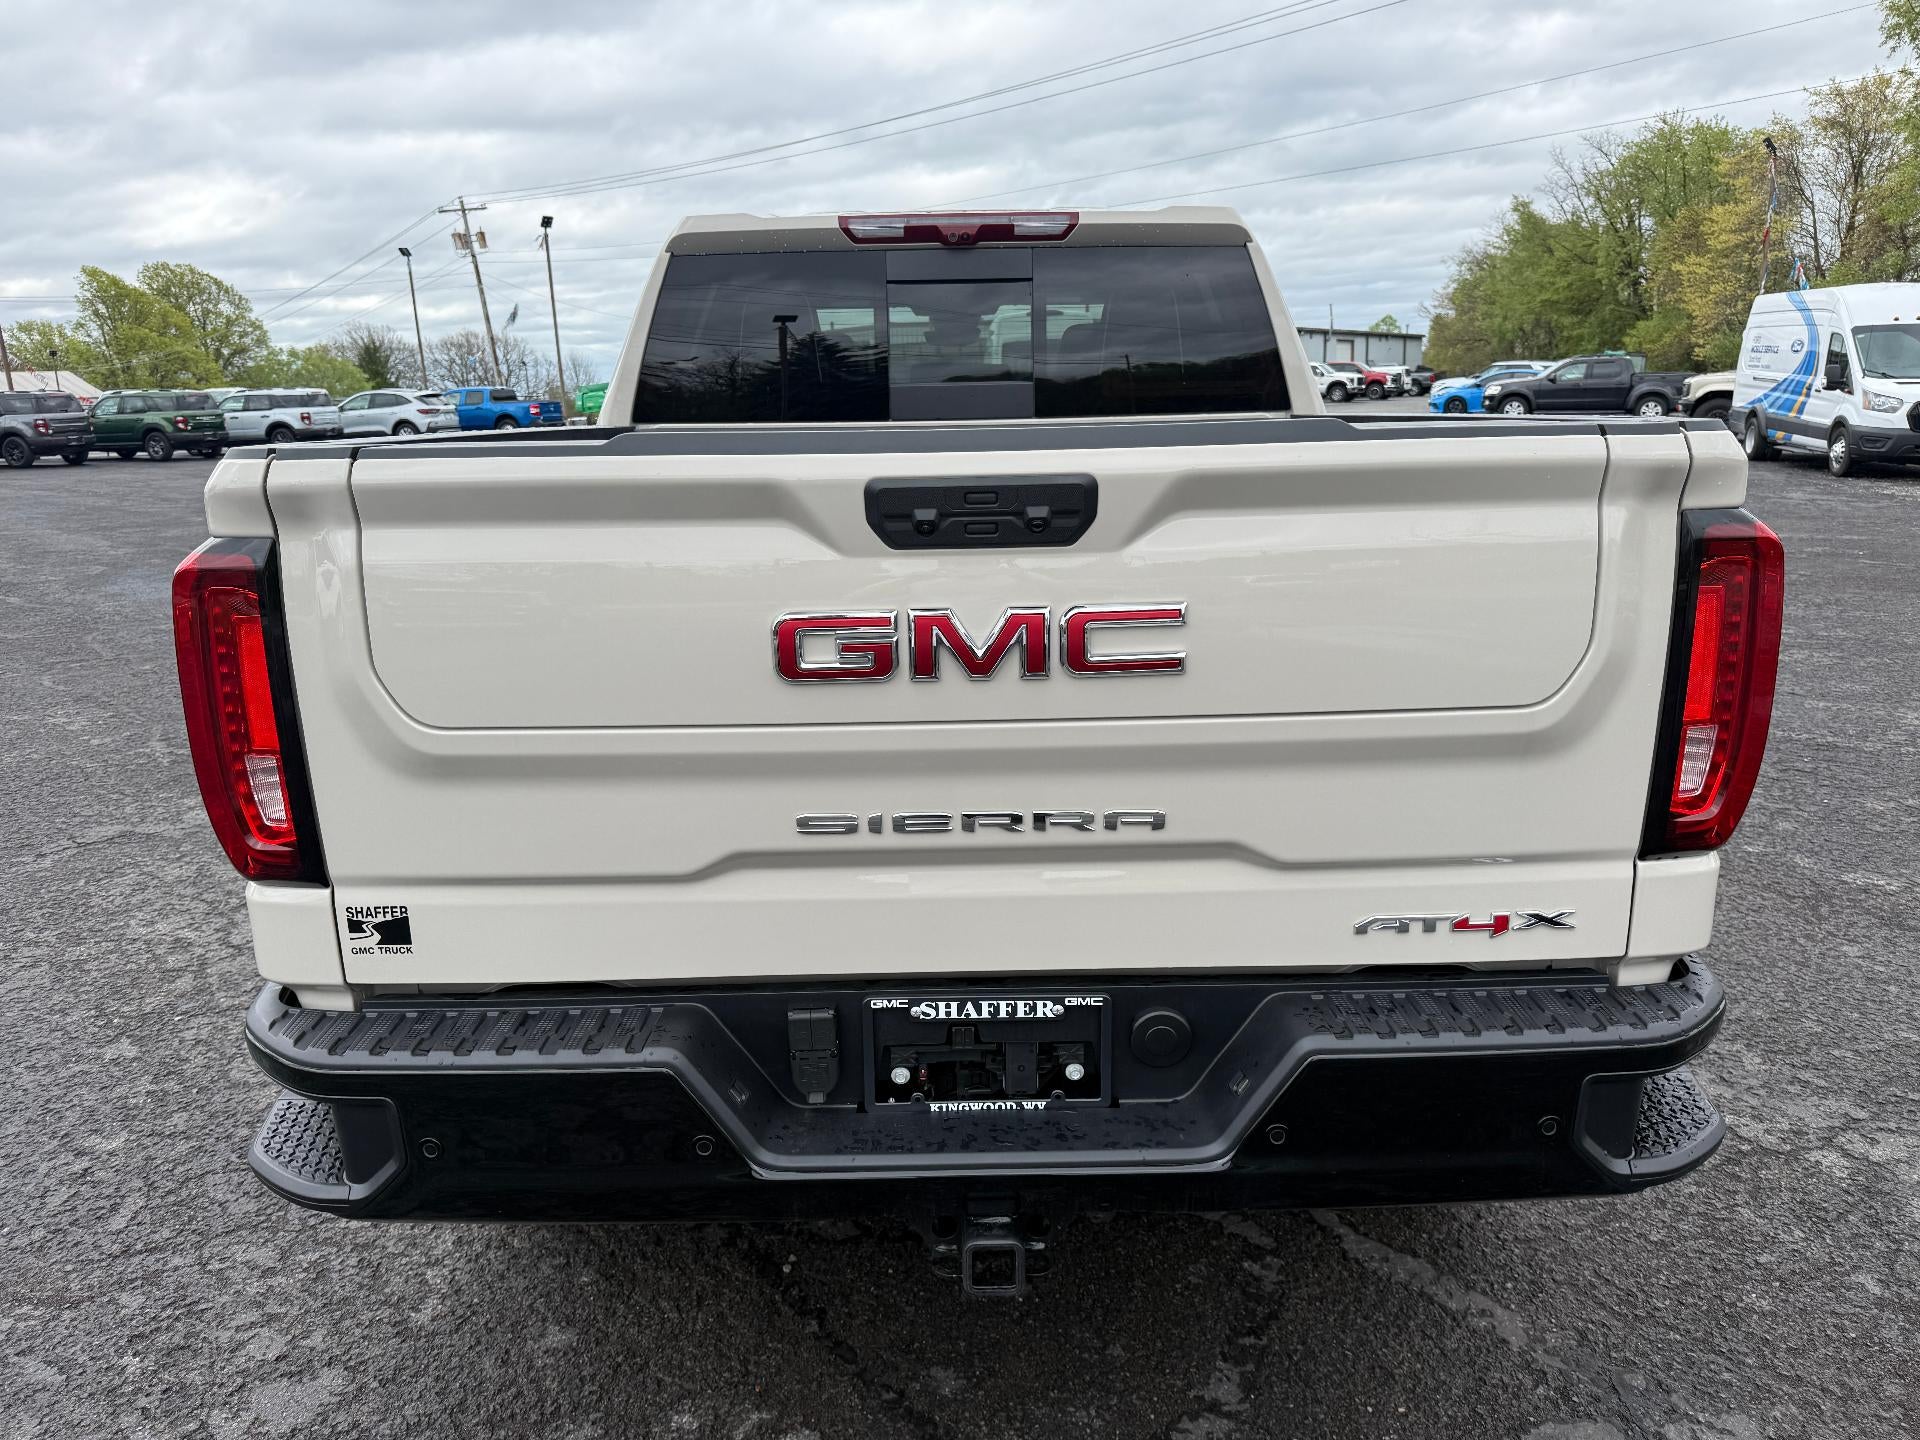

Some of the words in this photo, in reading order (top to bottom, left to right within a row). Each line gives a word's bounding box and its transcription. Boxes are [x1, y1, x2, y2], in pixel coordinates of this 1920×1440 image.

[772, 601, 1188, 684] GMC
[796, 809, 1167, 834] SIERRA
[345, 905, 409, 919] SHAFFER
[1353, 908, 1577, 939] AT4X
[351, 946, 375, 955] GMC
[378, 946, 414, 955] TRUCK
[870, 999, 909, 1009] GMC
[919, 1000, 1056, 1020] SHAFFER
[1064, 997, 1104, 1007] GMC
